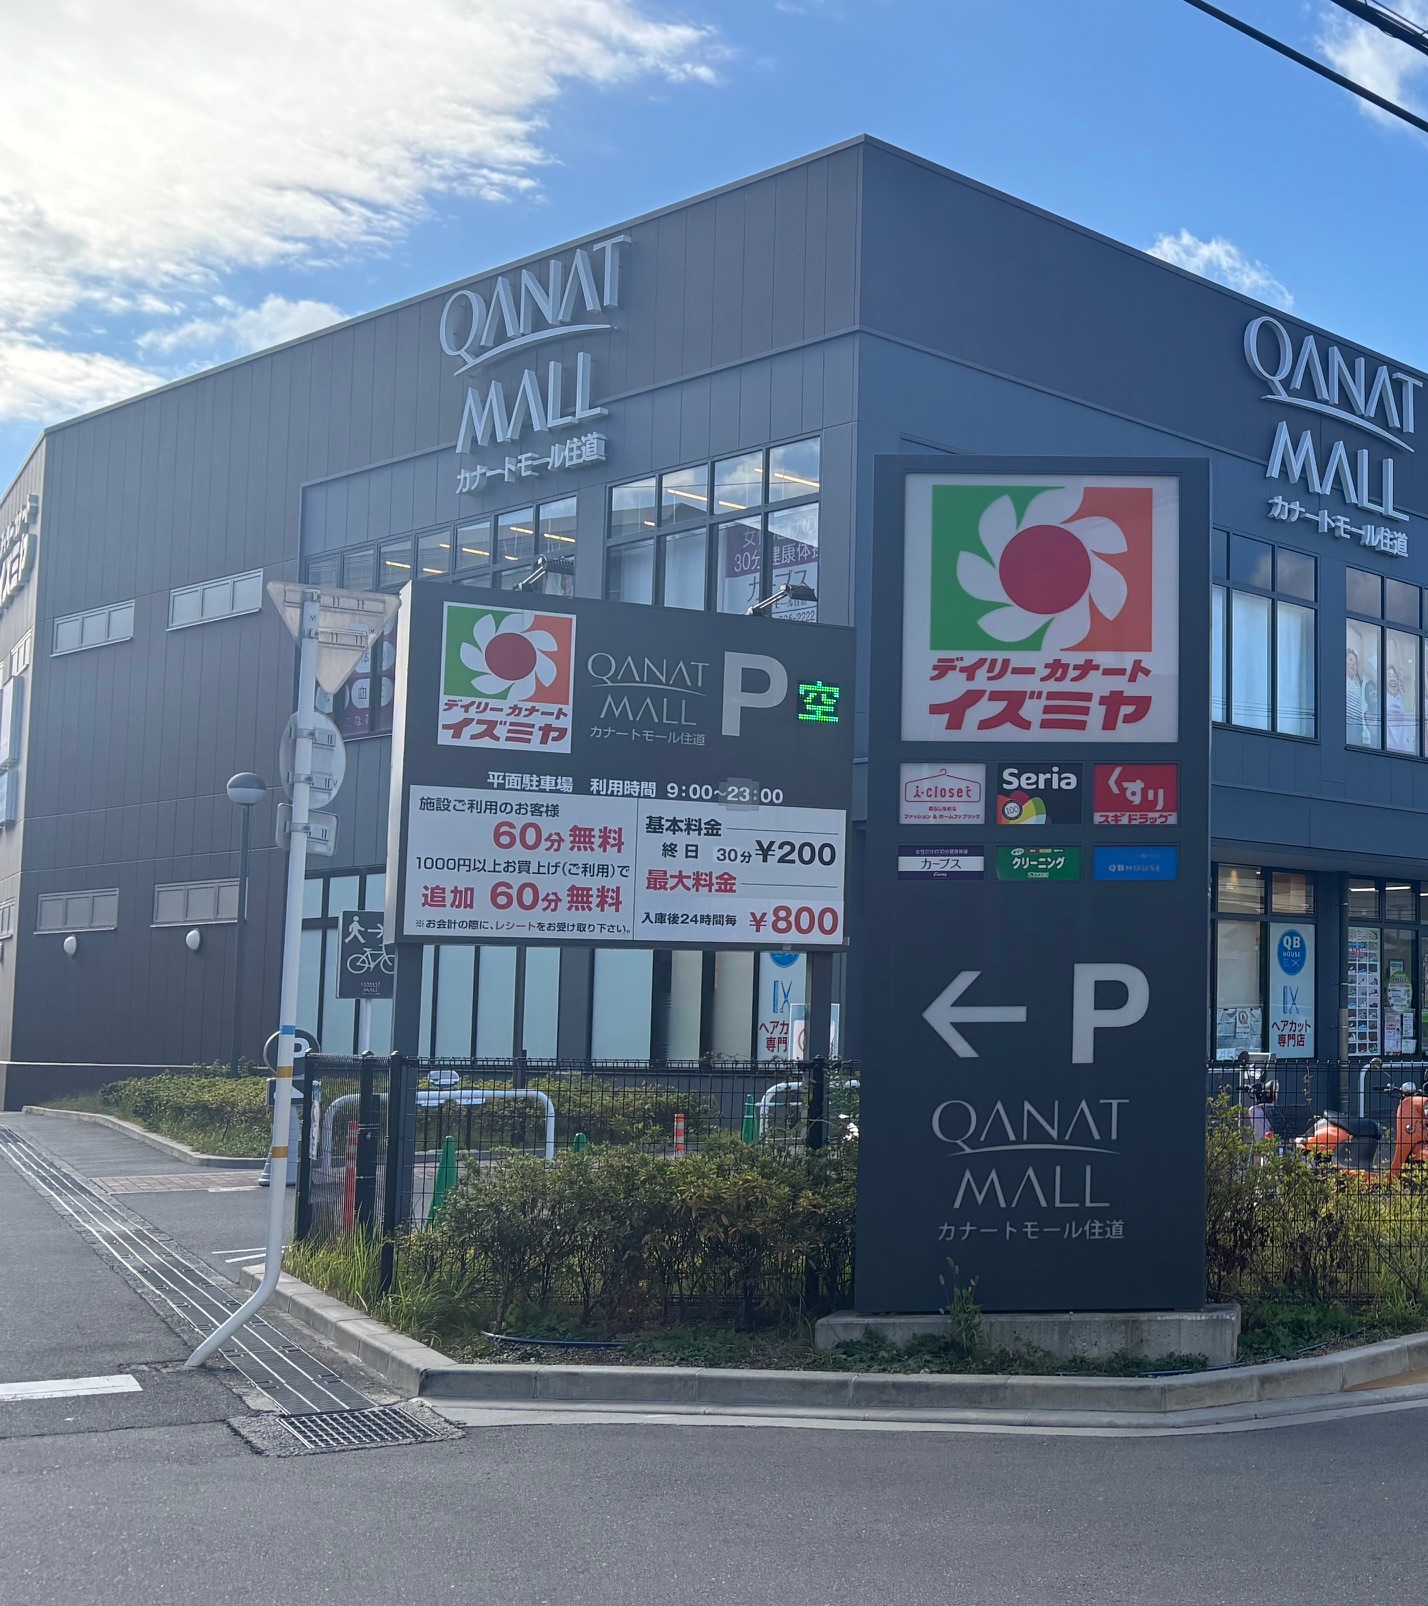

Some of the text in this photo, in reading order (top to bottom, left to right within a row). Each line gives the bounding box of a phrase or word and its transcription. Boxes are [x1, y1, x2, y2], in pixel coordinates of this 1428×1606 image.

[440, 235, 631, 367] QANAT
[1243, 316, 1423, 433] QANAT
[456, 352, 608, 453] MALL
[456, 431, 608, 494] カナートモール住道
[1266, 420, 1410, 521] MALL
[1267, 495, 1409, 558] カナートモール住道
[587, 652, 709, 688] QANAT
[721, 651, 788, 737] P
[798, 680, 840, 724] 空
[600, 694, 697, 726] MALL
[928, 689, 1153, 731] イズミヤ
[441, 717, 568, 745] イズミヤ
[590, 725, 706, 746] カナートモール住道
[487, 771, 573, 793] 平面駐車場
[590, 777, 656, 797] 利用時間
[1002, 766, 1078, 790] Seria
[1108, 766, 1164, 811] くすり
[419, 796, 560, 818] 施設ご利用のお客様
[492, 820, 625, 854] 60分無料
[645, 815, 722, 837] 基本料金
[920, 858, 962, 870] カーブス
[1012, 856, 1066, 870] クリーニング
[421, 884, 475, 910] 追加
[645, 869, 737, 894] 最大料金
[641, 905, 839, 936] 入庫後24時間毎 ¥800
[1283, 935, 1301, 950] QB
[759, 1021, 789, 1035] ヘアカ
[1072, 962, 1150, 1064] P
[1271, 1020, 1311, 1033] ヘアカット
[766, 1036, 788, 1053] 専門
[1277, 1034, 1306, 1048] 専門店
[931, 1098, 1130, 1152] QANAT
[953, 1165, 1110, 1208] MALL
[938, 1219, 1125, 1241] カナートモール住道
